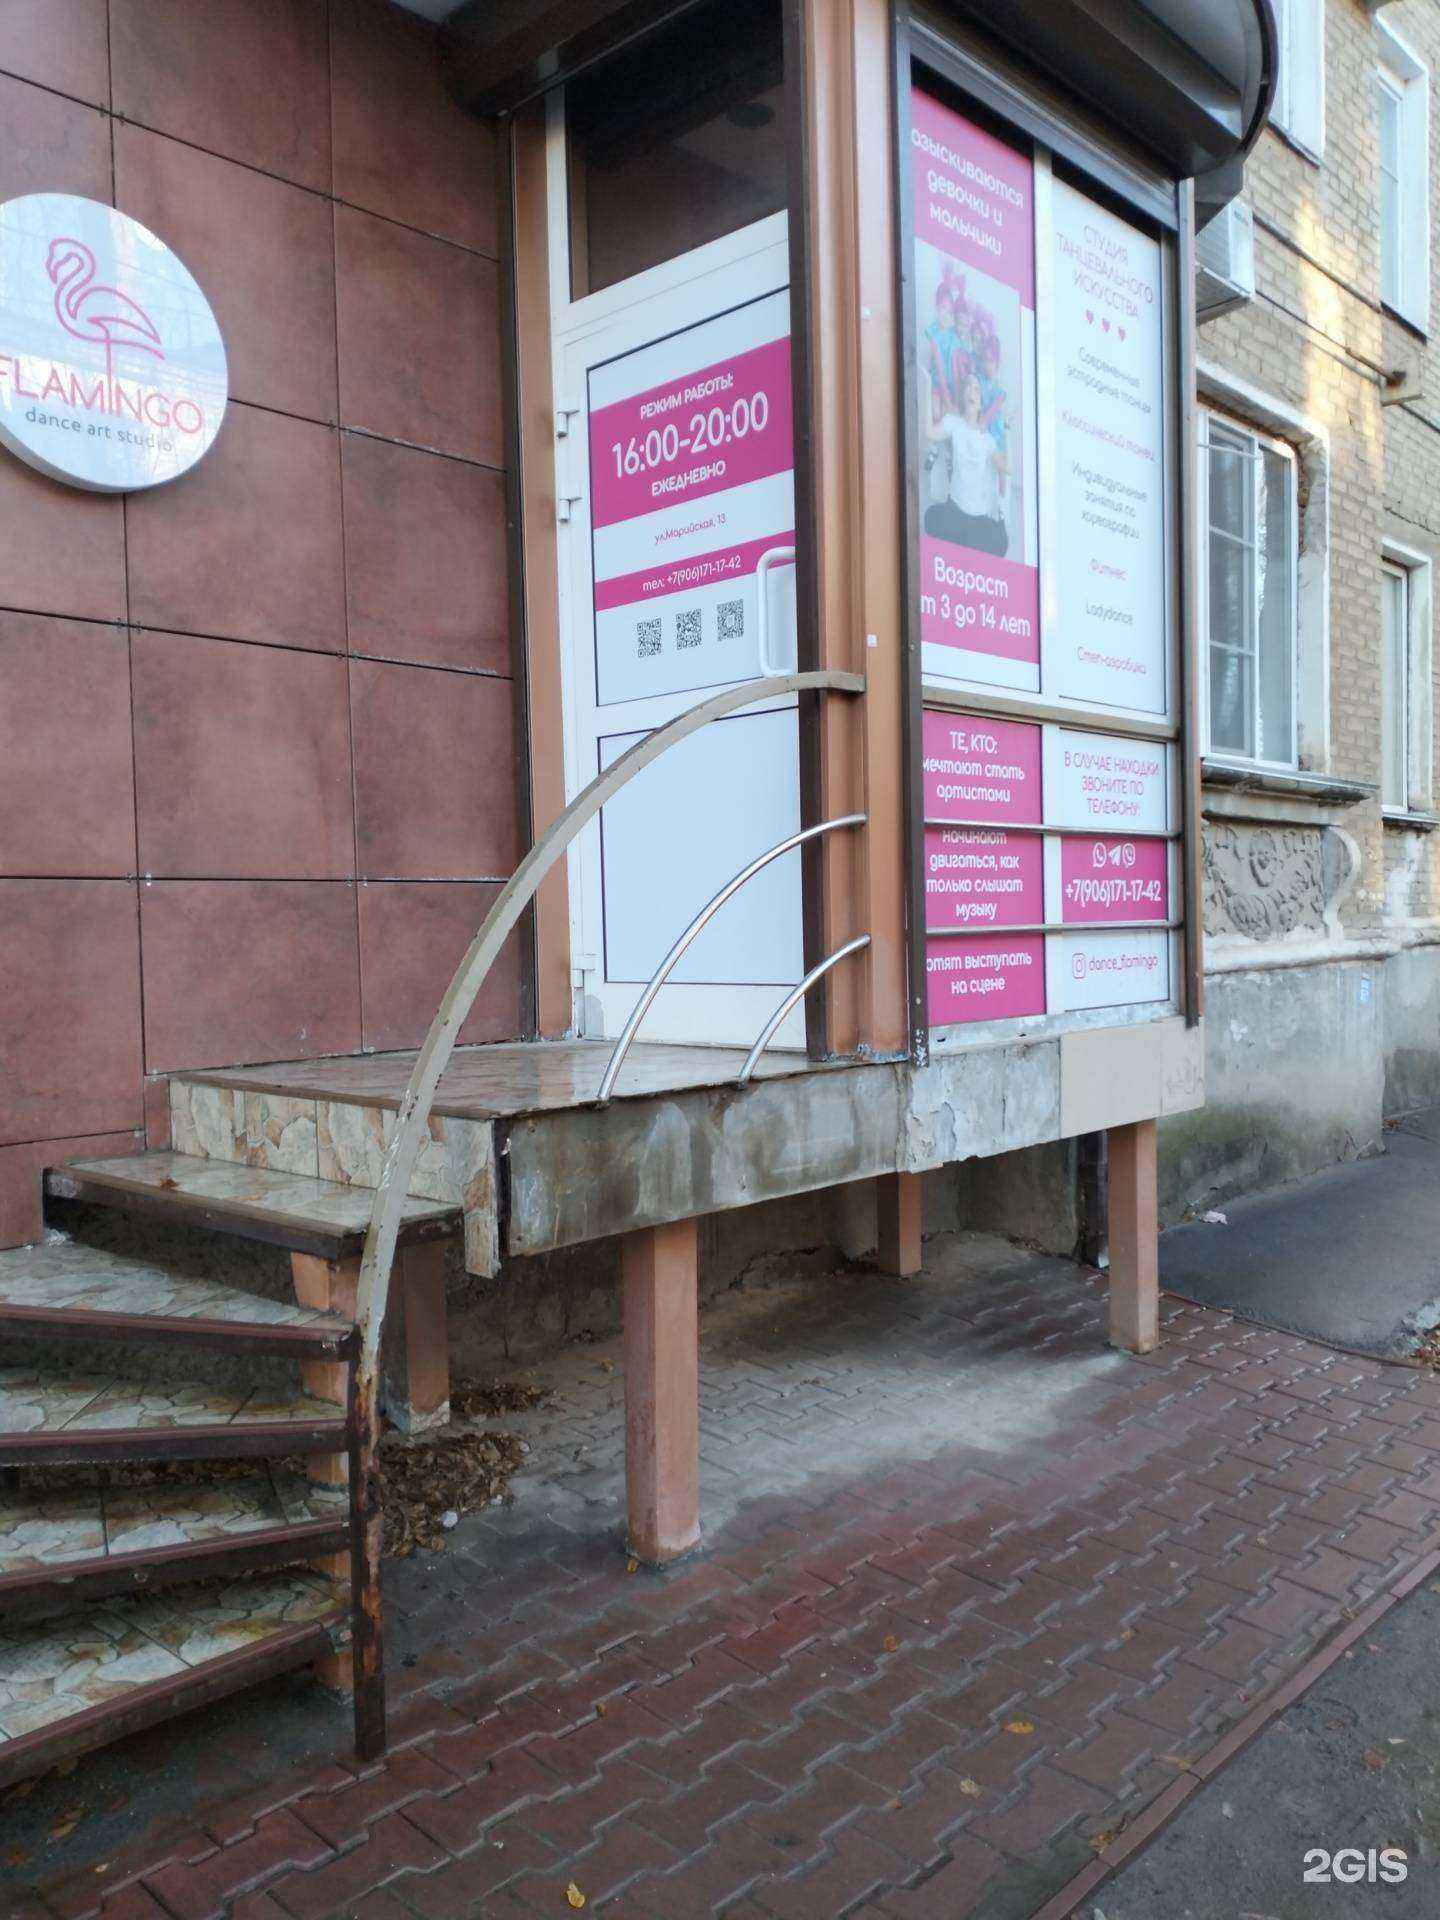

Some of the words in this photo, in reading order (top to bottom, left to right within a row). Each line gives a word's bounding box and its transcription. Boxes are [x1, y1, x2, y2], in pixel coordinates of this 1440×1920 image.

[911, 128, 1024, 209] азыскиваются
[927, 170, 990, 219] девочки
[993, 210, 1004, 227] и
[929, 202, 1003, 256] мальчики
[1084, 225, 1128, 265] СТУДИЯ
[1056, 232, 1154, 304] ТАНЦЕВАЛЬНОГО
[1073, 269, 1140, 318] ИСКУССТВА
[640, 392, 682, 420] РЕЖИМ
[684, 372, 734, 403] РАБОТЫ:
[25, 407, 81, 433] dance
[87, 423, 111, 440] art
[117, 429, 173, 453] studio
[612, 391, 769, 479] 16:00-20:00
[652, 460, 726, 497] ЕЖЕДНЕВНО
[717, 512, 727, 525] 13
[667, 555, 741, 586] +7(906)171-17-42
[934, 556, 1009, 599] Возраст
[920, 594, 936, 616] т
[940, 594, 951, 619] 3
[954, 604, 976, 629] до
[980, 603, 996, 629] 14
[1000, 614, 1031, 637] лет
[949, 731, 969, 754] ТЕ,
[971, 734, 998, 754] КТО:
[985, 763, 1026, 781] стать
[1064, 751, 1071, 767] В
[1073, 752, 1112, 772] СЛУЧАЕ
[1115, 757, 1159, 778] НАХОДКИ
[936, 784, 1011, 803] артистами
[1081, 775, 1127, 796] ЗВОНИТЕ
[1129, 780, 1144, 796] ПО
[942, 830, 1008, 845] начинают
[929, 854, 999, 872] двигаться,
[1000, 855, 1021, 869] как
[926, 877, 972, 894] только
[974, 878, 1023, 893] слышат
[1065, 878, 1162, 908] +7(906)171-17-42
[955, 902, 998, 921] музыку
[926, 957, 962, 973] отят
[964, 951, 1033, 972] выступать
[951, 981, 968, 995] на
[970, 975, 1006, 995] сцене
